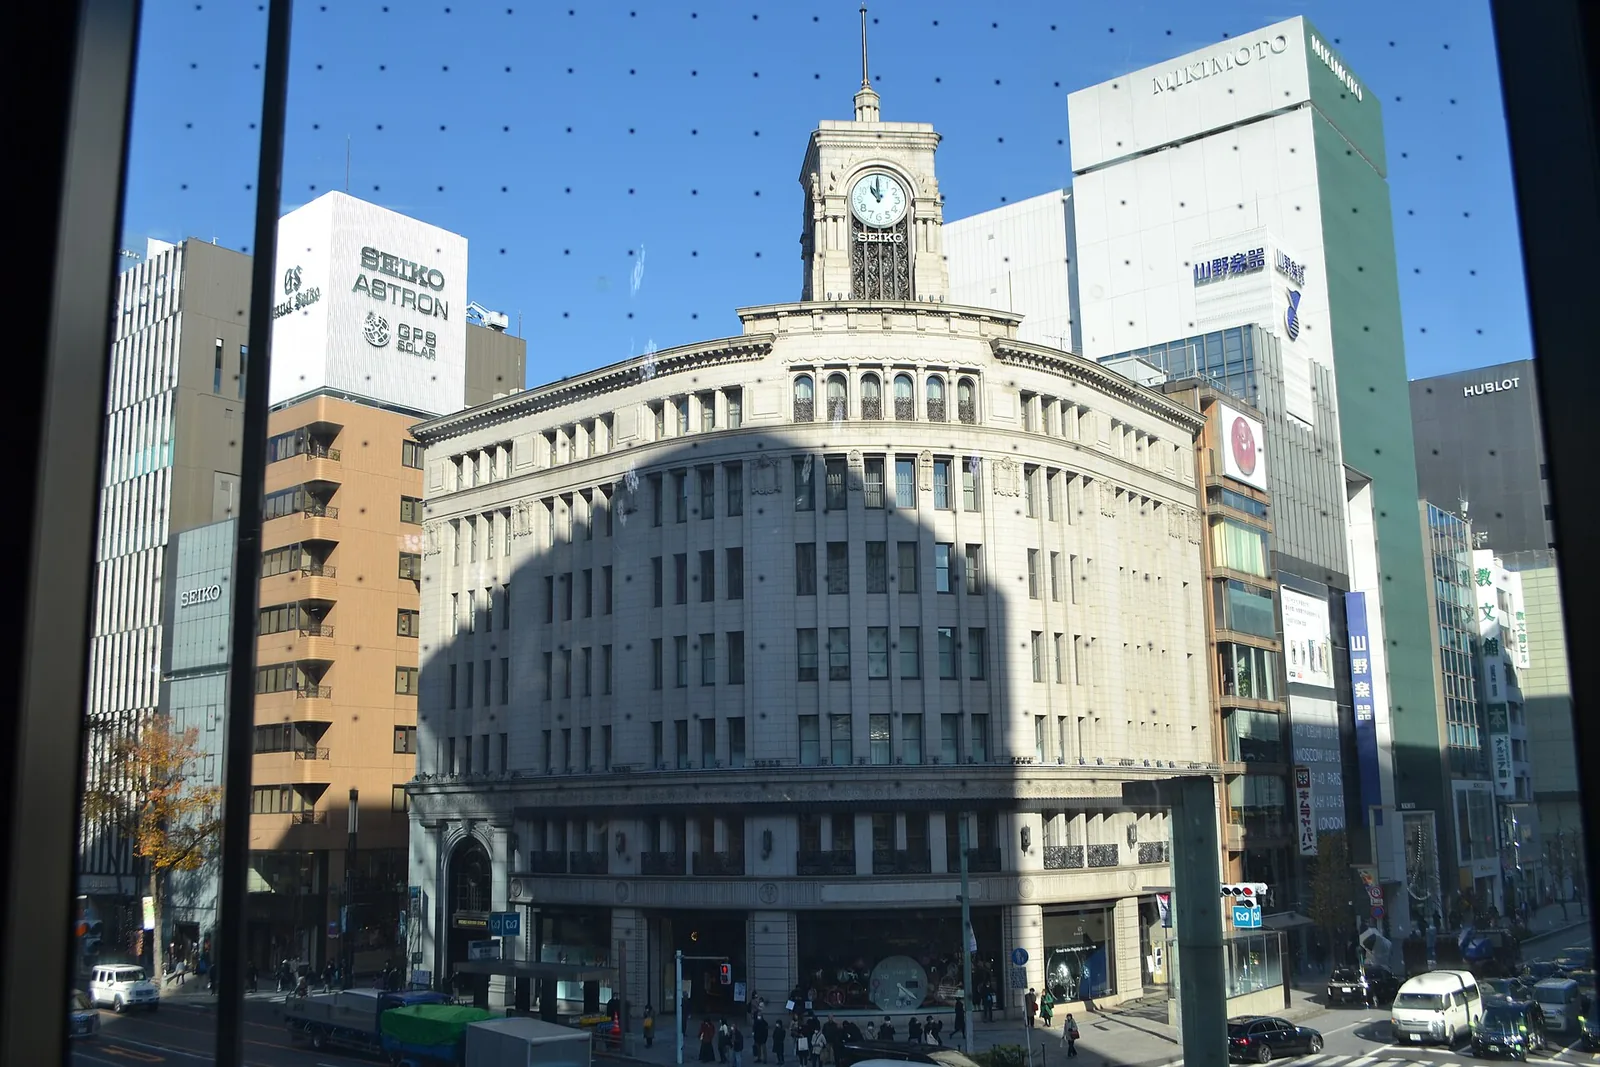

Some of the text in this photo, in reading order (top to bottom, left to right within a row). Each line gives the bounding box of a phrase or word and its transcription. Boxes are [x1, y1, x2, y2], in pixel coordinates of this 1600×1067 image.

[1151, 34, 1289, 95] MIKIMOTO
[1311, 33, 1363, 102] MIKIMOTO
[857, 232, 904, 243] SEIKO
[360, 245, 445, 292] SEIKO
[1194, 246, 1265, 281] 山野楽器
[352, 273, 449, 321] ASTRON
[397, 322, 437, 348] GPS
[397, 339, 437, 362] SOLAR
[1463, 377, 1520, 398] HUBLOT
[181, 584, 222, 608] SEIKO
[1475, 567, 1500, 657] 教文館
[1350, 635, 1373, 721] 山野楽器
[1318, 816, 1344, 831] LONDON
